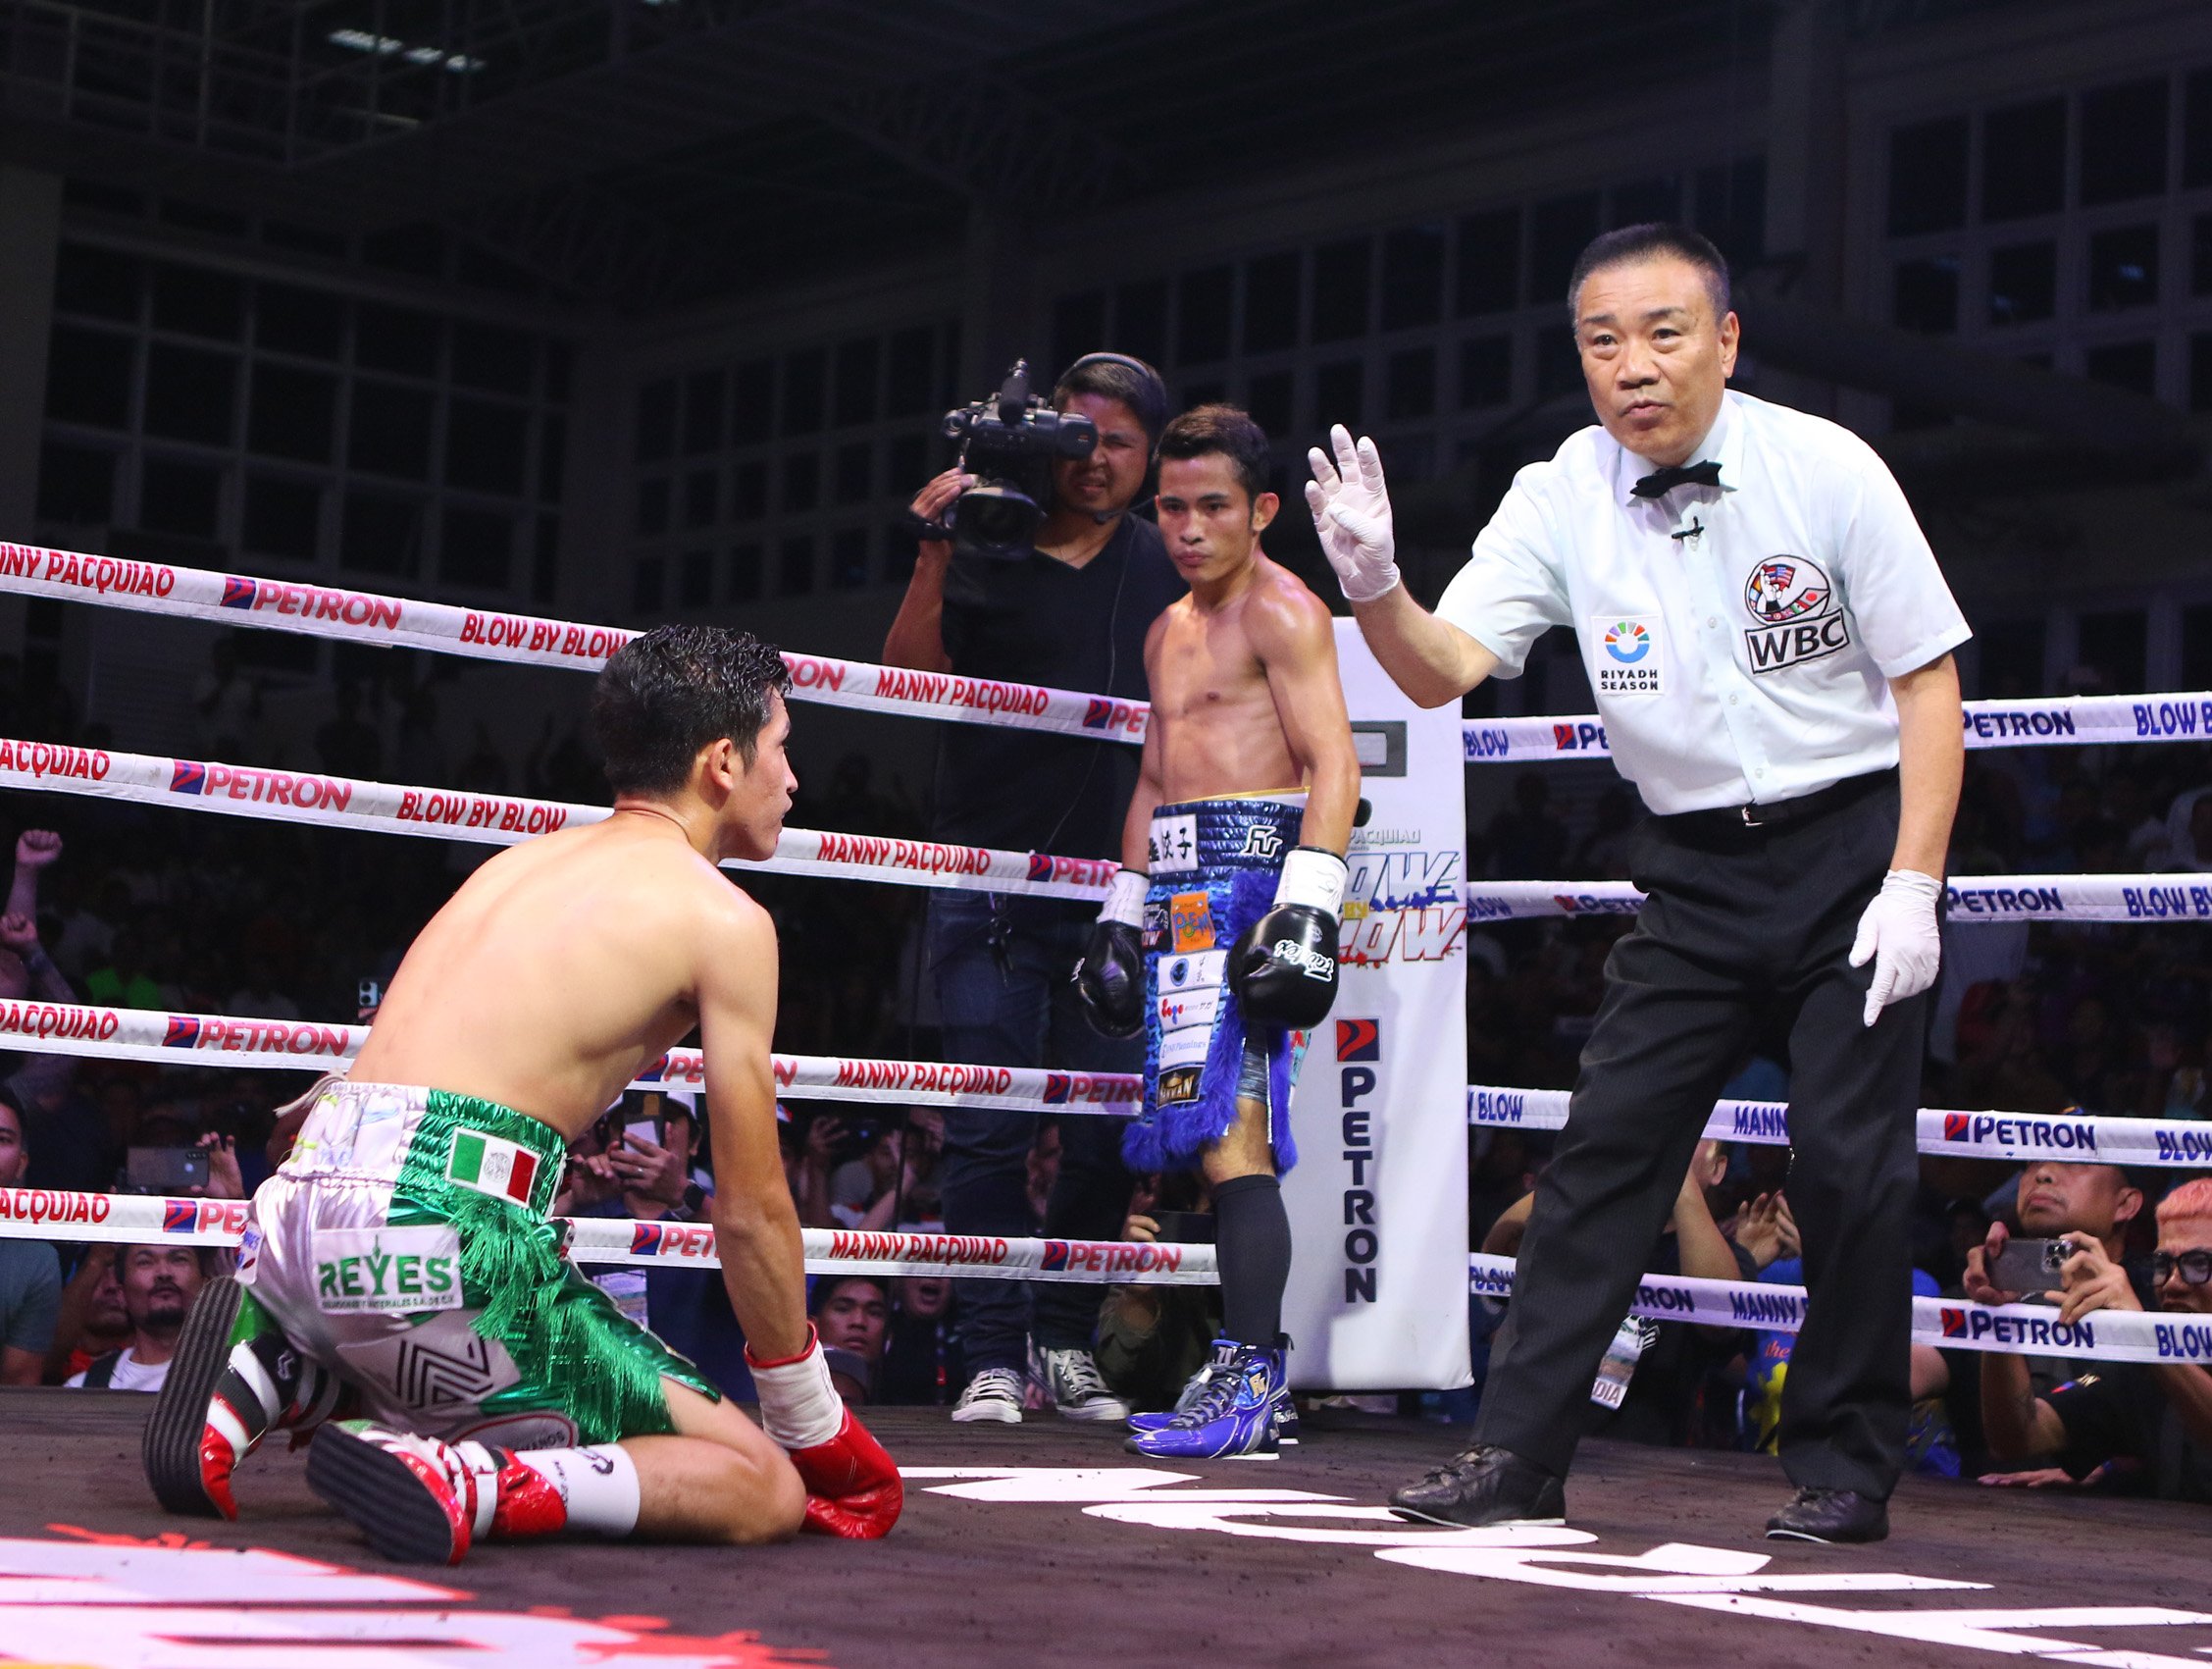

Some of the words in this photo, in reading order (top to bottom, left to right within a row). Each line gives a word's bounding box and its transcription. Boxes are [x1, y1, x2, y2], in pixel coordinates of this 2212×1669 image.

[45, 551, 175, 595] PACQUIAO
[253, 581, 402, 629] PETRON
[460, 613, 527, 649] BLOW
[529, 619, 560, 652] BY
[874, 669, 950, 704] MANNY
[950, 679, 1049, 716] PACQUIAO
[1750, 615, 1844, 666] WBC
[1601, 669, 1658, 680] RIYADH
[1602, 681, 1659, 691] SEASON
[2134, 702, 2197, 736] BLOW
[0, 739, 110, 780] ACQUIAO
[205, 762, 352, 811] PETRON
[396, 791, 467, 825] BLOW
[468, 797, 501, 828] BY
[498, 802, 567, 834] BLOW
[817, 834, 898, 865] MANNY
[892, 841, 991, 876] PACQUIAO
[1052, 857, 1121, 888] PETR
[1946, 885, 2064, 913] PETRON
[2123, 887, 2187, 917] BLOW
[197, 1019, 349, 1057] PETRON
[836, 1061, 909, 1090] MANNY
[912, 1065, 1011, 1096] PACQUIAO
[1067, 1075, 1143, 1104] PETR
[1478, 1092, 1524, 1122] BLOW
[1733, 1106, 1789, 1136] MANN
[1974, 1114, 2095, 1150] PETRON
[1341, 1067, 1378, 1303] PETRON
[0, 1188, 110, 1225] ACQUIAO
[829, 1232, 904, 1261] MANNY
[905, 1236, 1007, 1266] PACQUIAO
[1066, 1243, 1182, 1274] PETRON
[319, 1254, 452, 1297] REYES
[1632, 1285, 1695, 1313] RON
[1729, 1291, 1797, 1325] MANNY
[1971, 1310, 2093, 1348] PETRON
[1593, 1381, 1620, 1405] DIA
